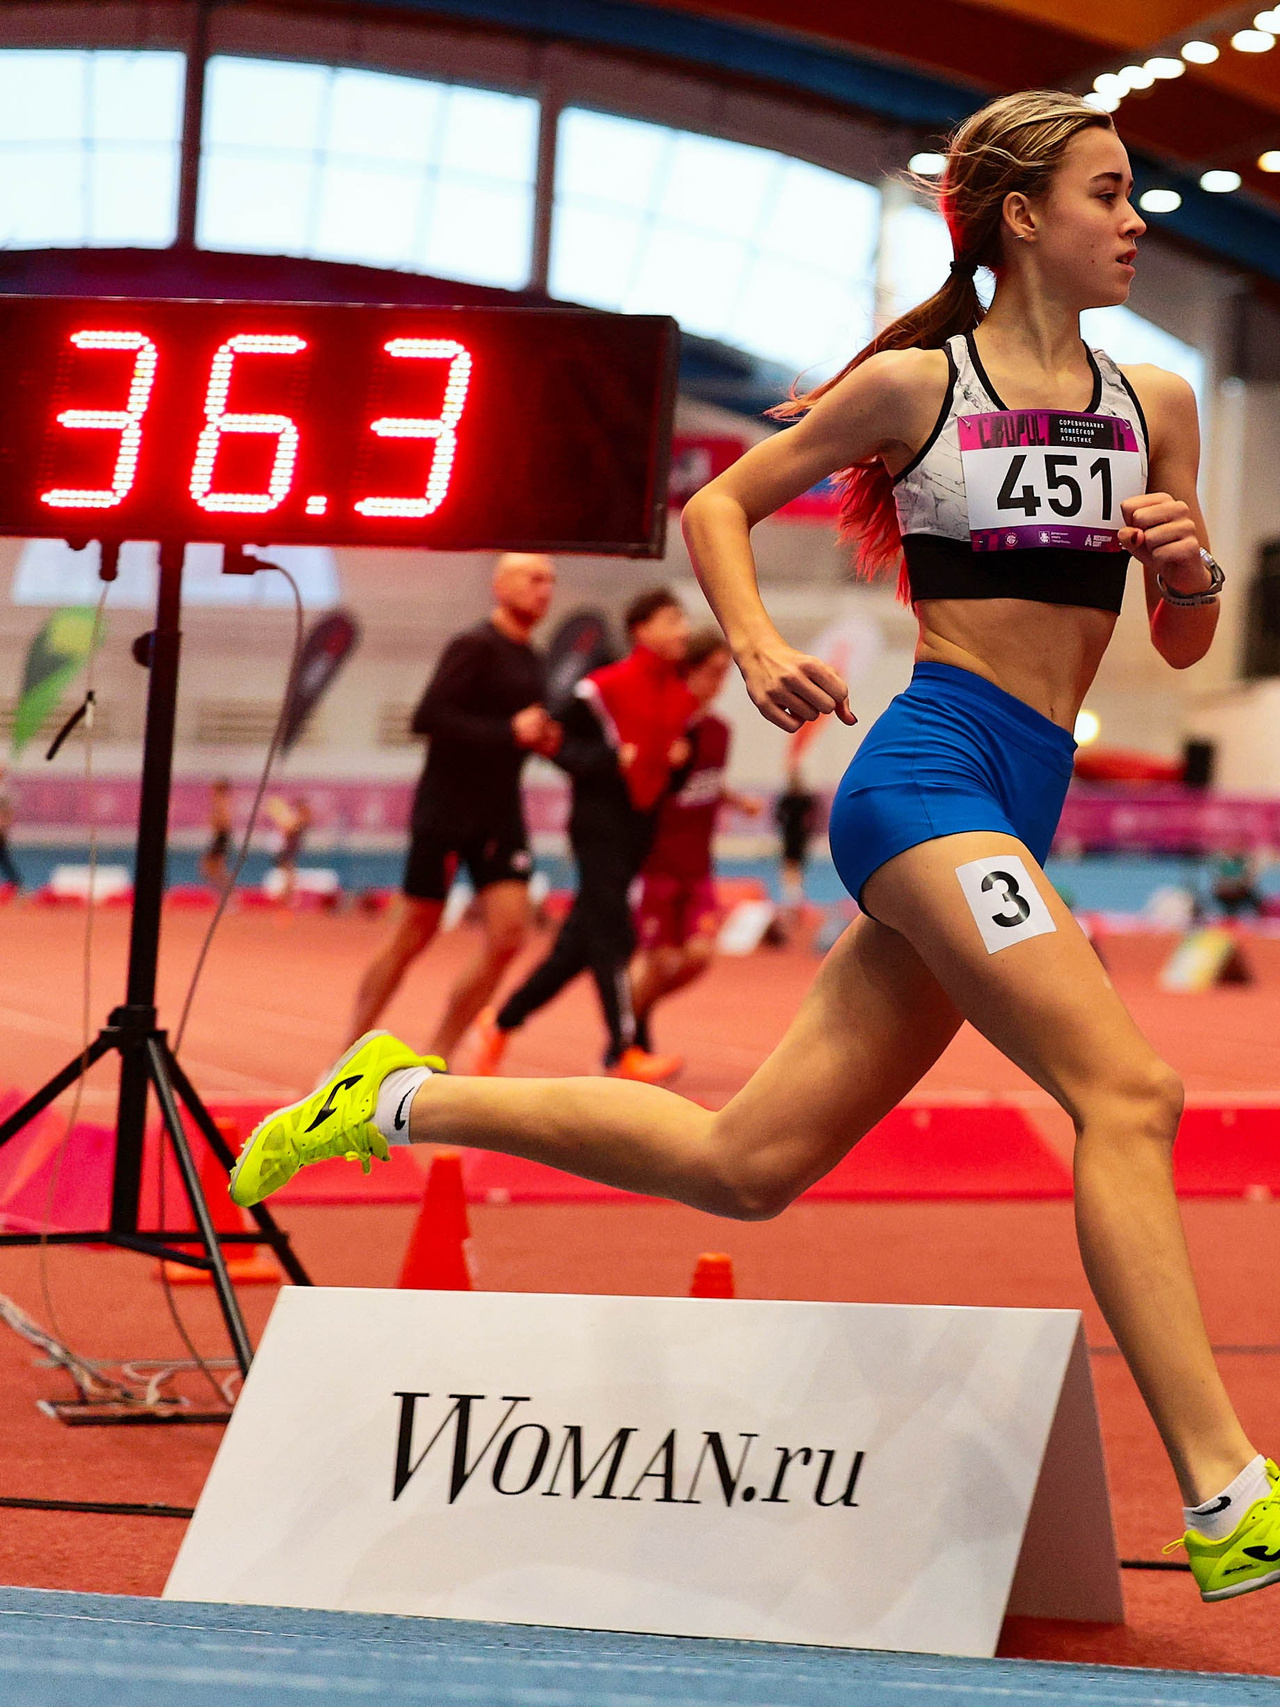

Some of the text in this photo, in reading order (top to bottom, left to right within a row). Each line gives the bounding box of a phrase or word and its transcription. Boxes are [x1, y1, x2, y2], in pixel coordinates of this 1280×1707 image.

[40, 330, 473, 518] 36.3
[1060, 436, 1092, 444] АТЛЕТИКЕ
[997, 454, 1112, 521] 451
[981, 871, 1031, 928] 3
[391, 1391, 866, 1508] WOMAN.ru
